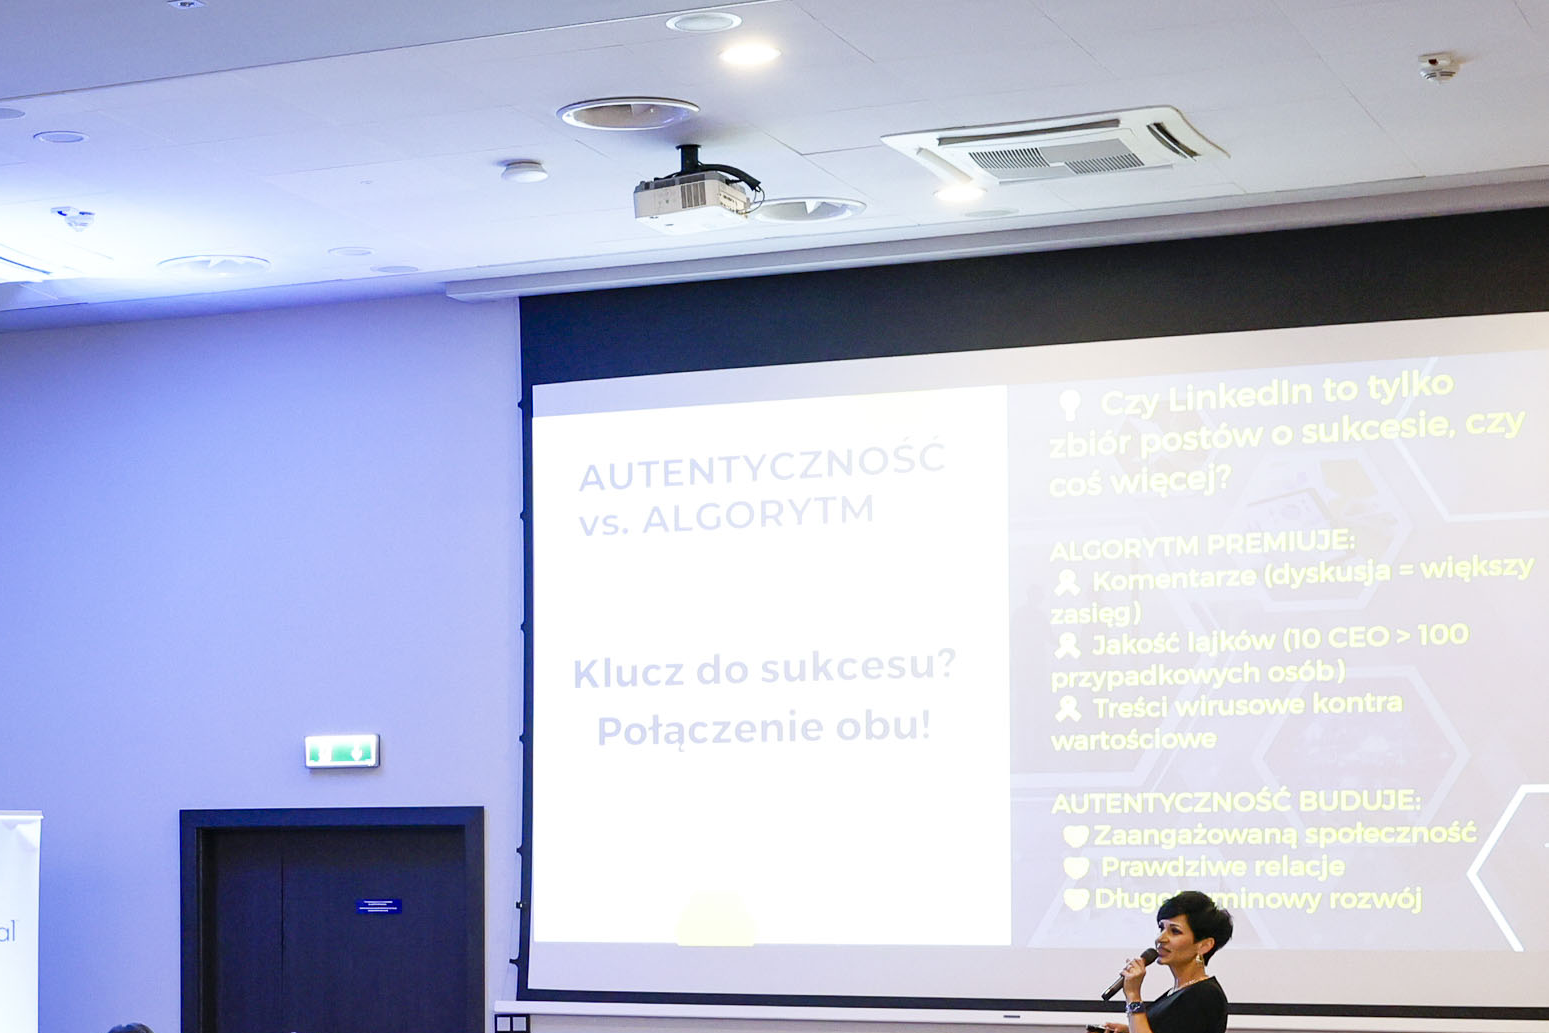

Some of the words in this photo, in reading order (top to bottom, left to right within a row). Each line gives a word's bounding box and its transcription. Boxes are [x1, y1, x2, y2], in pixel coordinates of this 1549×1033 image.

[1100, 390, 1160, 420] Czy
[1169, 379, 1313, 413] LinkedIn
[1322, 379, 1359, 402] to
[1367, 369, 1455, 407] tylko
[1050, 430, 1132, 461] zbiór
[1140, 424, 1264, 459] postów
[1270, 424, 1293, 447] o
[1302, 410, 1456, 445] sukcesie,
[1465, 409, 1526, 440] czy
[578, 436, 946, 493] AUTENTYCZNOŚĆ
[1050, 469, 1102, 498] coś
[1110, 462, 1234, 497] więcej?
[578, 513, 629, 537] vs.
[643, 494, 874, 534] ALGORYTM
[1050, 537, 1199, 563] ALGORYTM
[1207, 528, 1357, 557] PREMIUJE:
[1093, 567, 1257, 594] Komentarze
[1264, 558, 1393, 591] (dyskusja
[1420, 553, 1536, 584] większy
[1050, 601, 1143, 629] zasięg)
[1092, 631, 1181, 657] Jakość
[1188, 628, 1276, 658] lajków
[1283, 626, 1322, 653] (10
[1328, 624, 1391, 649] CEO
[1417, 622, 1471, 646] 100
[574, 657, 685, 688] Klucz
[696, 653, 749, 685] do
[761, 647, 957, 683] sukcesu?
[1050, 661, 1262, 694] przypadkowych
[1267, 658, 1347, 686] osób)
[1093, 695, 1168, 720] Treści
[1175, 694, 1306, 717] wirusowe
[1313, 690, 1404, 713] kontra
[598, 709, 824, 752] Połączenie
[836, 708, 931, 742] obu!
[1050, 727, 1218, 753] wartościowe
[1051, 786, 1292, 815] AUTENTYCZNOŚĆ
[1299, 788, 1423, 813] BUDUJE:
[1094, 823, 1298, 850] Zaangażowaną
[1305, 820, 1478, 850] społeczność
[1101, 855, 1248, 879] Prawdziwe
[1255, 854, 1347, 881] relacje
[1330, 887, 1424, 914] rozwój
